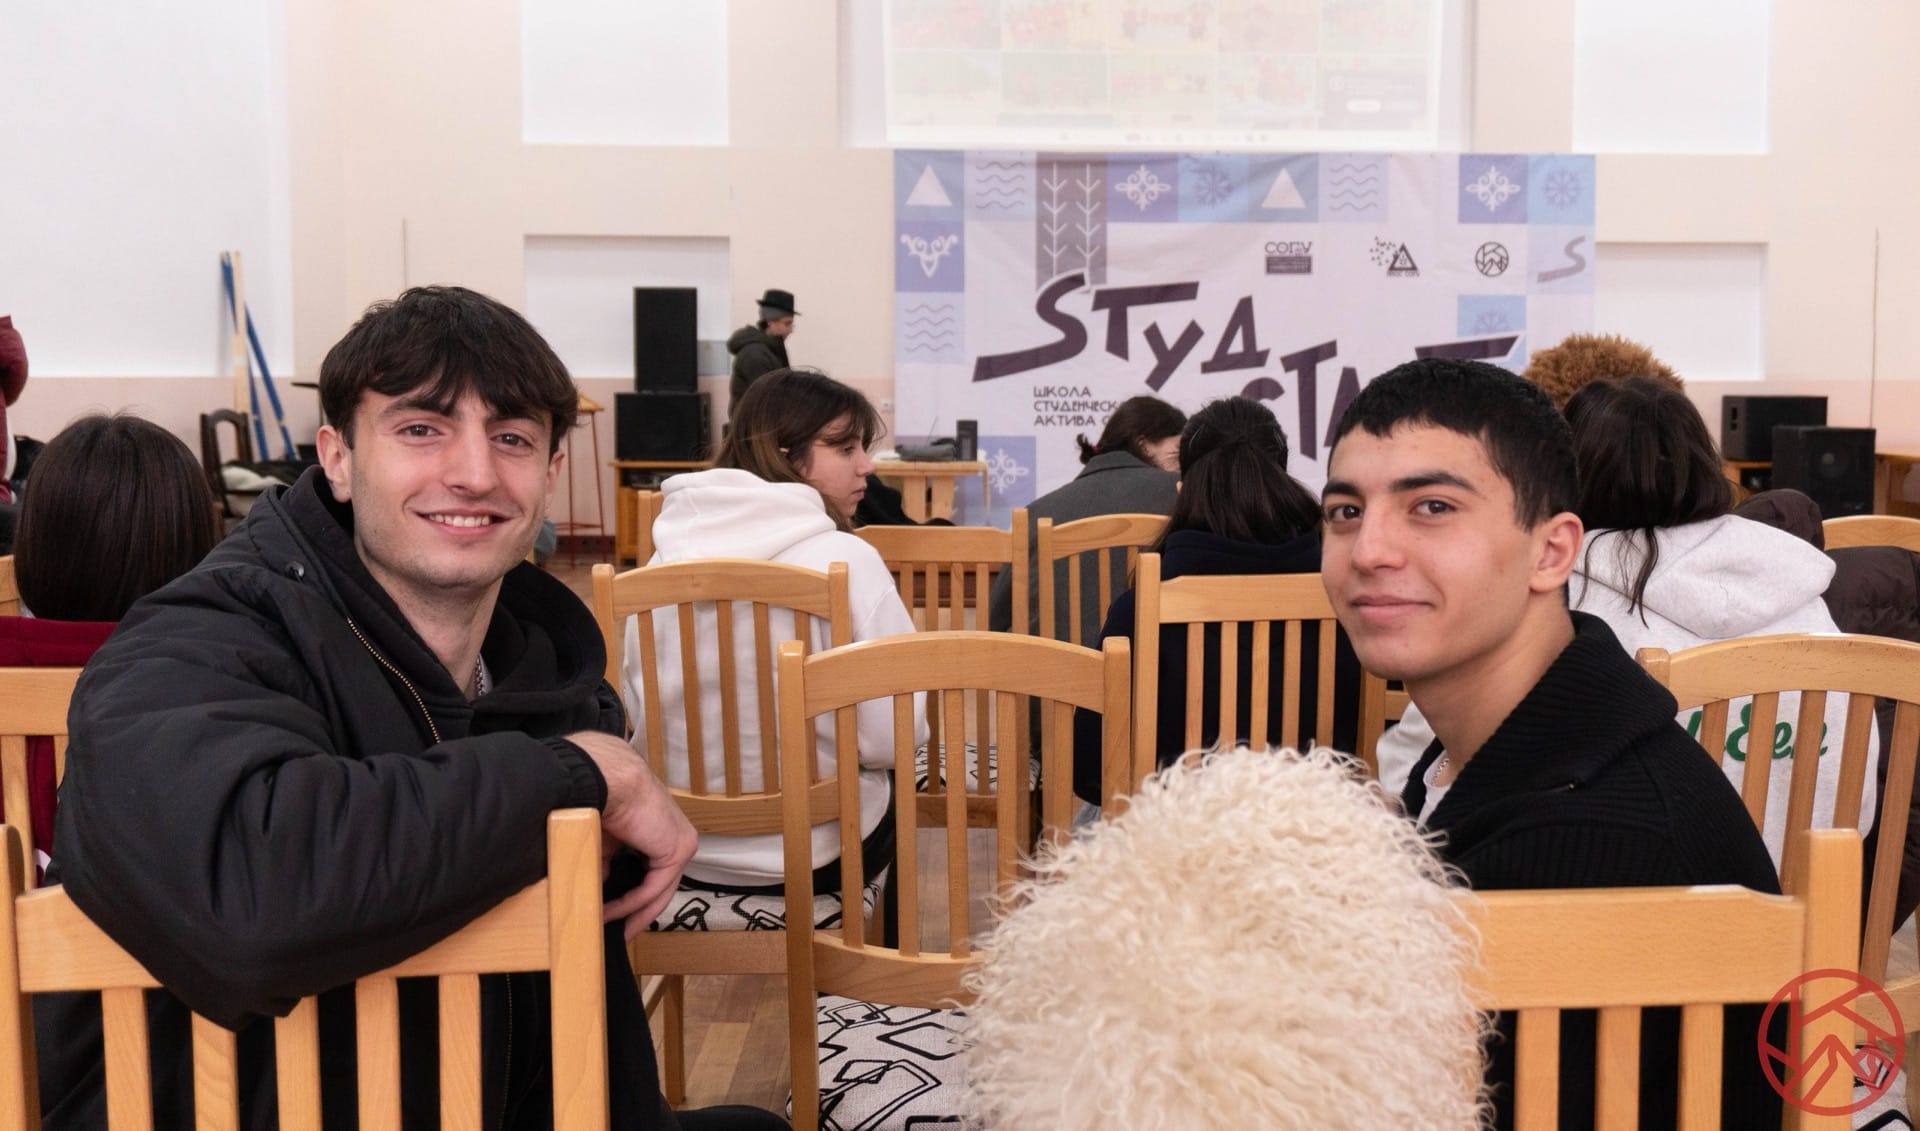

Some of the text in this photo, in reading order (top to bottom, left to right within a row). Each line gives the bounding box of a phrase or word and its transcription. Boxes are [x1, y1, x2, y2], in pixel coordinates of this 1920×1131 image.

[1264, 241, 1313, 254] СОГУ
[1033, 386, 1092, 398] ШКОЛА
[1033, 400, 1119, 412] СТУДЕНЧЕСК
[1033, 415, 1096, 426] АКТИВА
